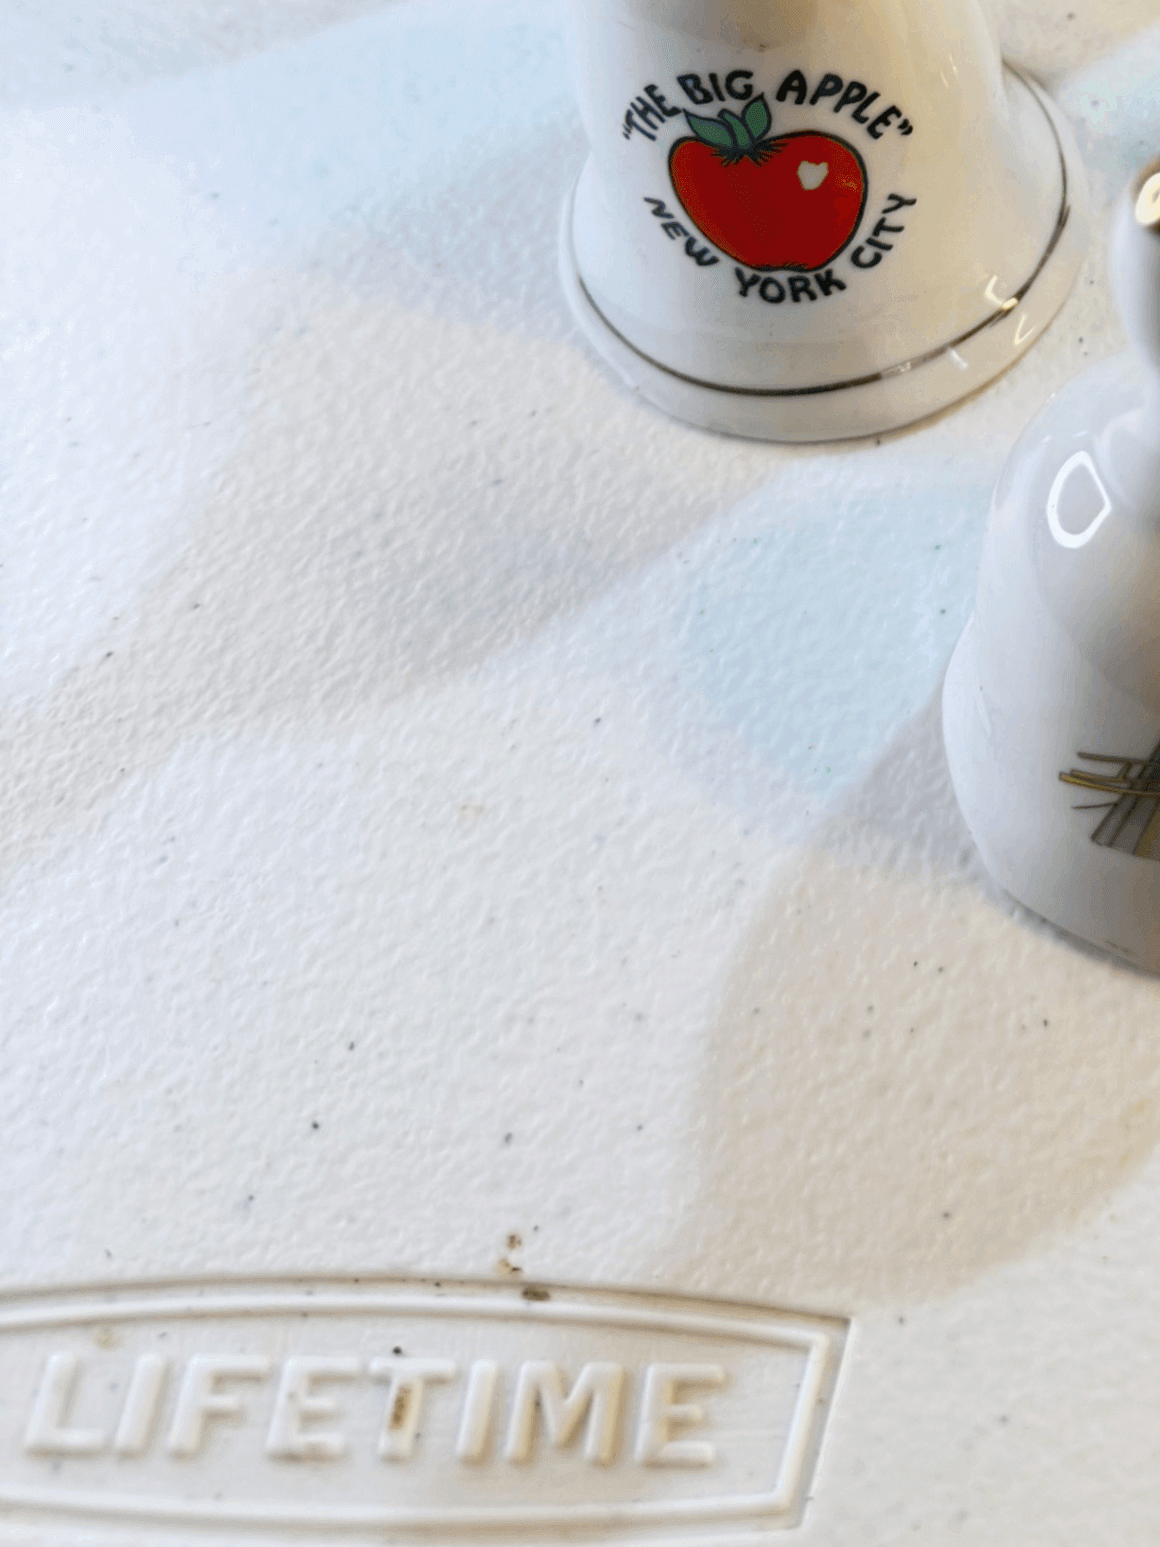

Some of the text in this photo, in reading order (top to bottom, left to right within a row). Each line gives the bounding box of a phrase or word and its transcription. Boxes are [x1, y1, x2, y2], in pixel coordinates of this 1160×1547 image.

[677, 69, 755, 106] BIG
[643, 193, 918, 305] NEW YORK CITY
[22, 1350, 727, 1468] LIFETIME
